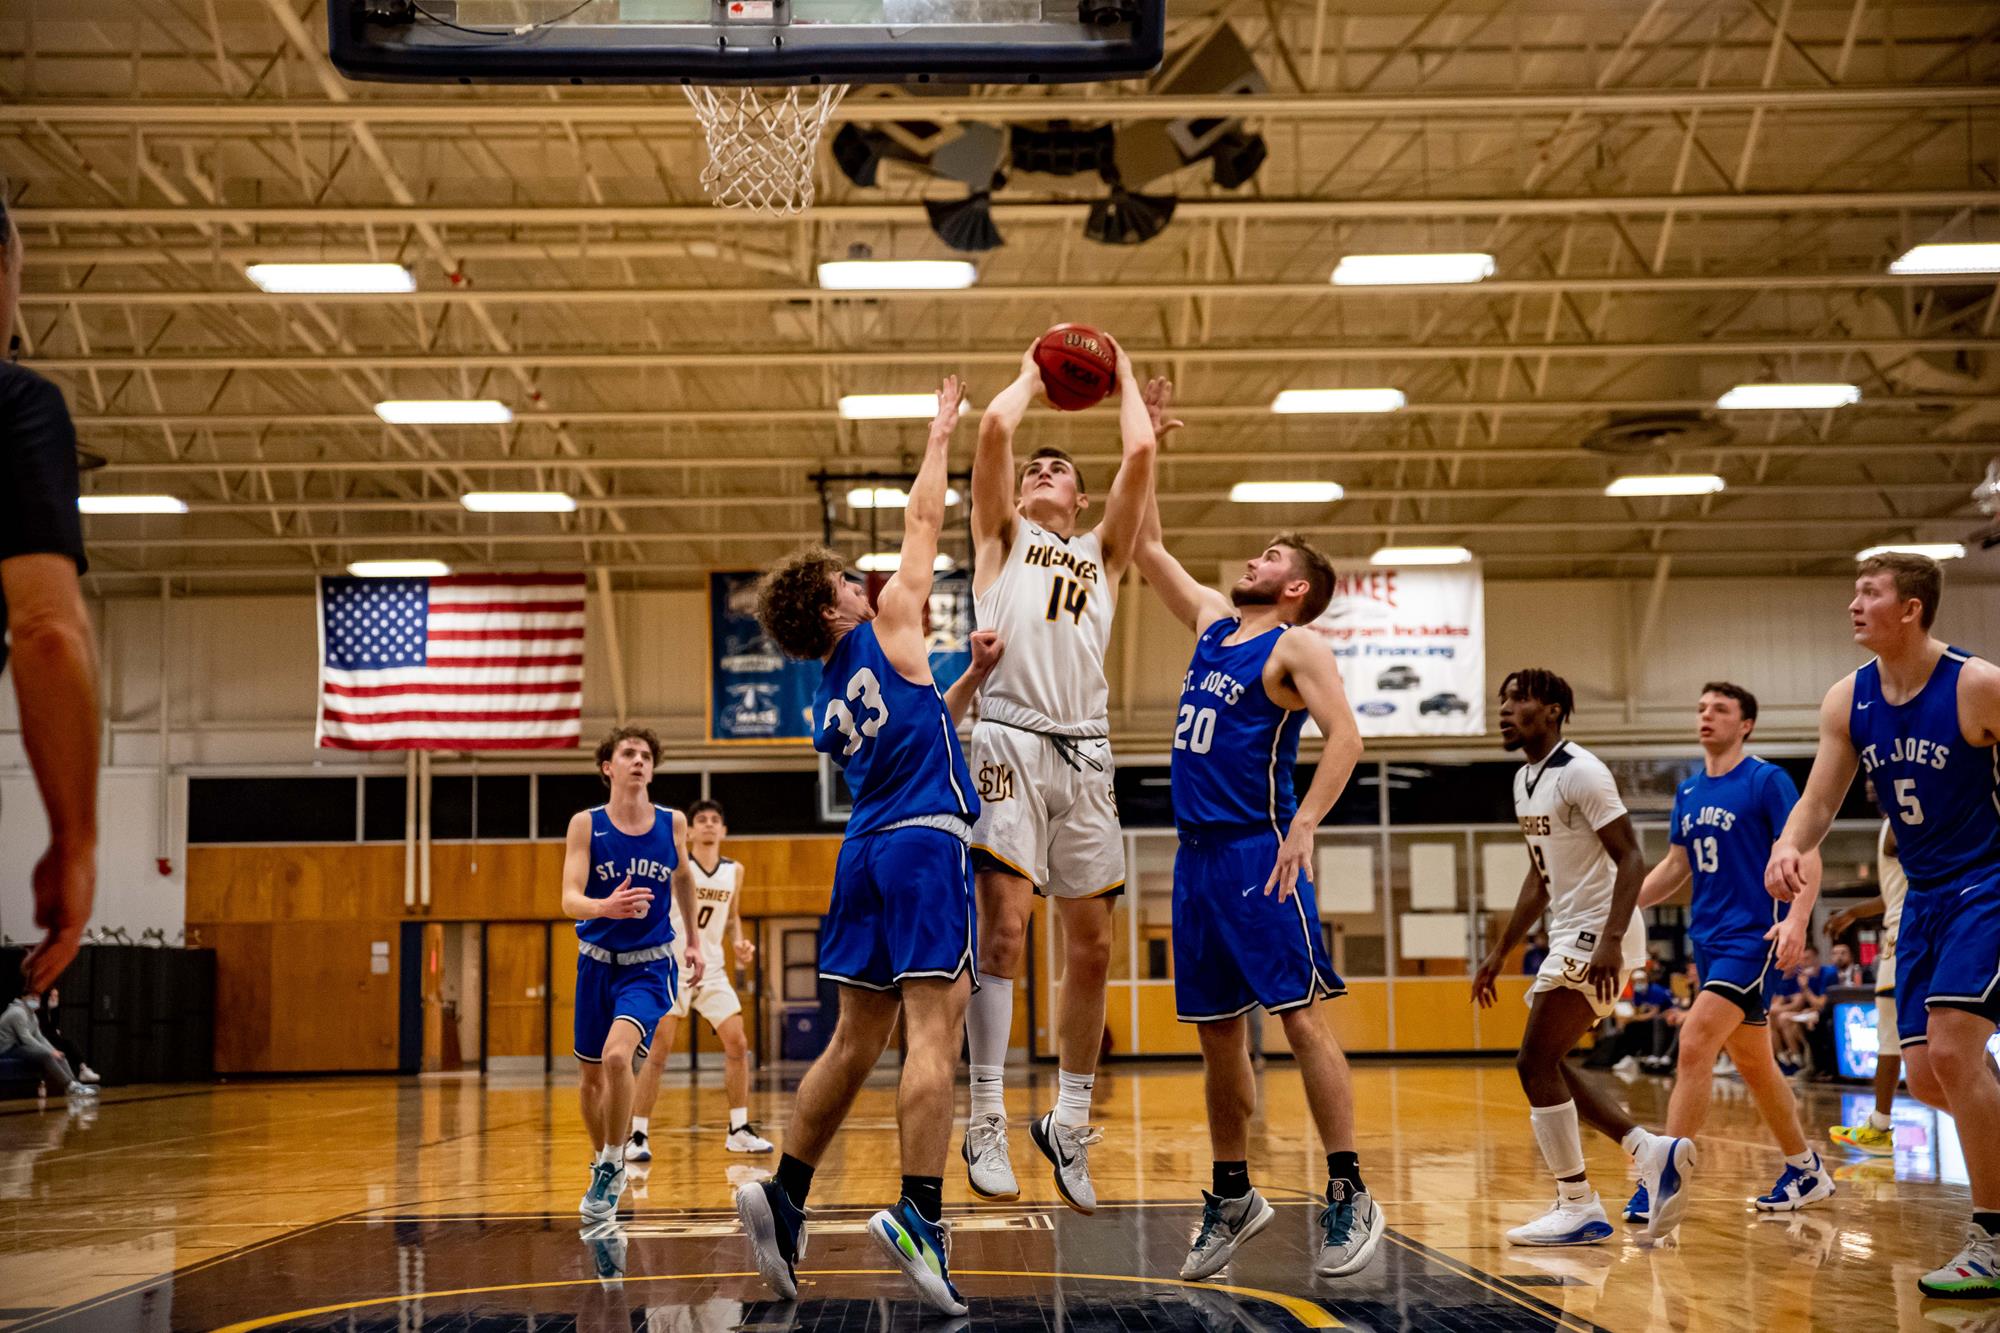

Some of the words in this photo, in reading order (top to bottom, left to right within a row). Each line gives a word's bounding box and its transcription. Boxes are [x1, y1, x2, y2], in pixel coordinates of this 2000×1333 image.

[1064, 333, 1114, 368] Wilson
[1045, 574, 1088, 626] 14
[1392, 623, 1470, 638] Includes
[1364, 642, 1456, 660] Financing
[1199, 670, 1246, 706] JOE'S
[823, 667, 889, 756] 33
[1173, 703, 1218, 755] 20
[1862, 743, 1886, 774] ST.
[1890, 737, 1950, 770] JOE'S
[1893, 778, 1925, 826] 5
[1681, 812, 1694, 837] ST.
[1695, 806, 1736, 832] JOE'S
[595, 860, 621, 881] ST.
[625, 857, 672, 883] JOE'S
[1693, 836, 1719, 874] 13
[697, 905, 714, 930] 0
